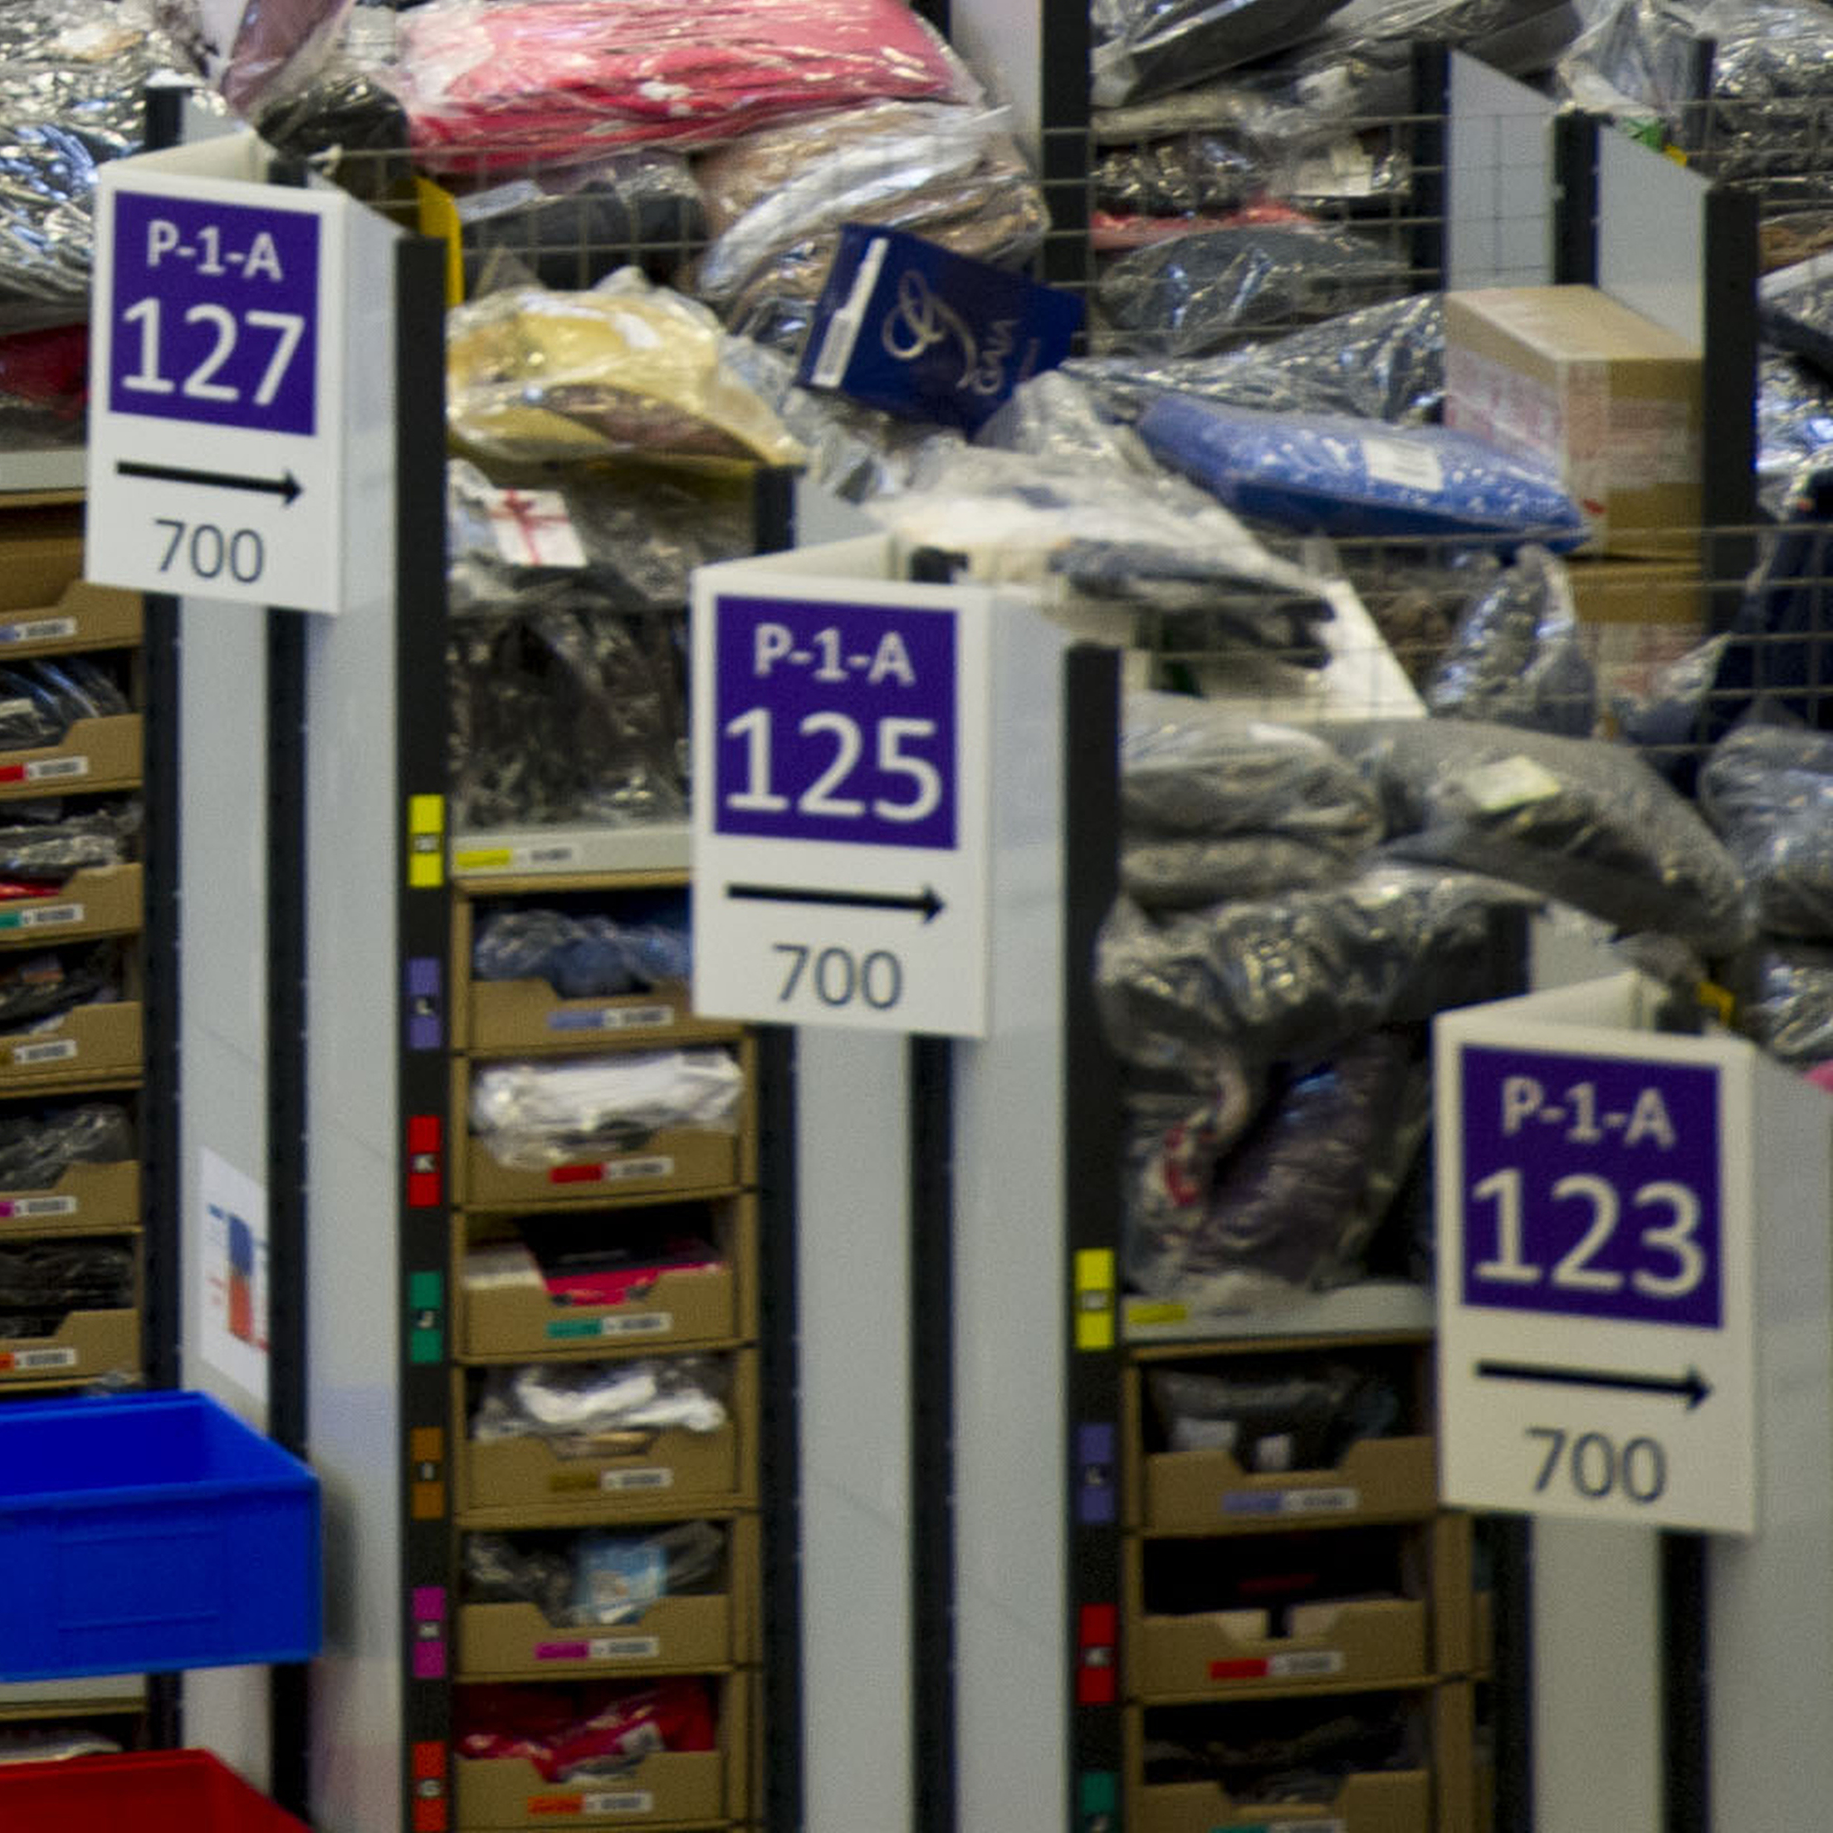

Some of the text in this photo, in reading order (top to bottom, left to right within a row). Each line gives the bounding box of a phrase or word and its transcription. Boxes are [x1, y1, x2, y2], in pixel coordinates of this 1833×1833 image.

[148, 220, 282, 280] P-1-A
[123, 298, 304, 405] 127
[155, 519, 264, 584] 700
[755, 623, 914, 683] P-1-A
[728, 709, 941, 821] 125
[773, 944, 903, 1011] 700
[1503, 1077, 1674, 1146] P-1-A
[1475, 1169, 1703, 1296] 123
[1526, 1427, 1666, 1504] 700
